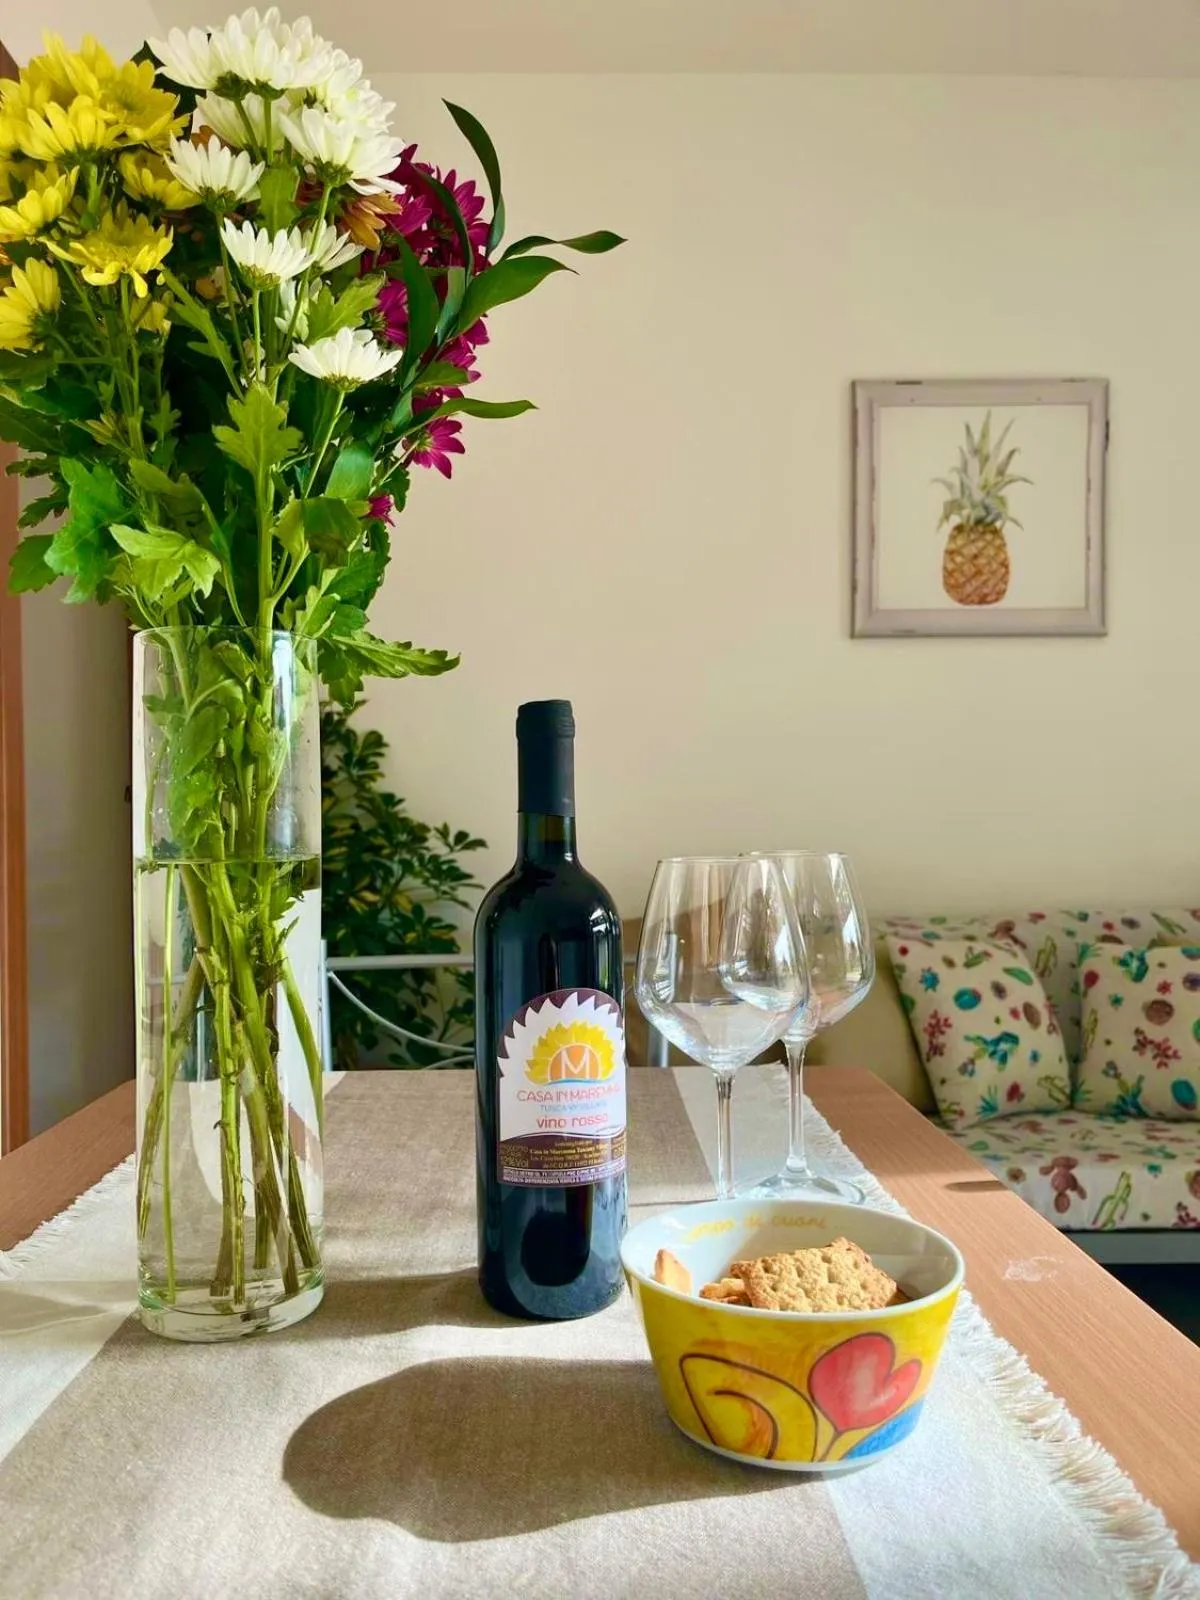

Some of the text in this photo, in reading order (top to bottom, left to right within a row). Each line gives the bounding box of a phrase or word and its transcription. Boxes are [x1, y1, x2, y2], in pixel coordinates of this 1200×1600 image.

[517, 1089, 554, 1102] CASA
[555, 1088, 569, 1102] IN
[536, 1113, 609, 1129] vino rosso
